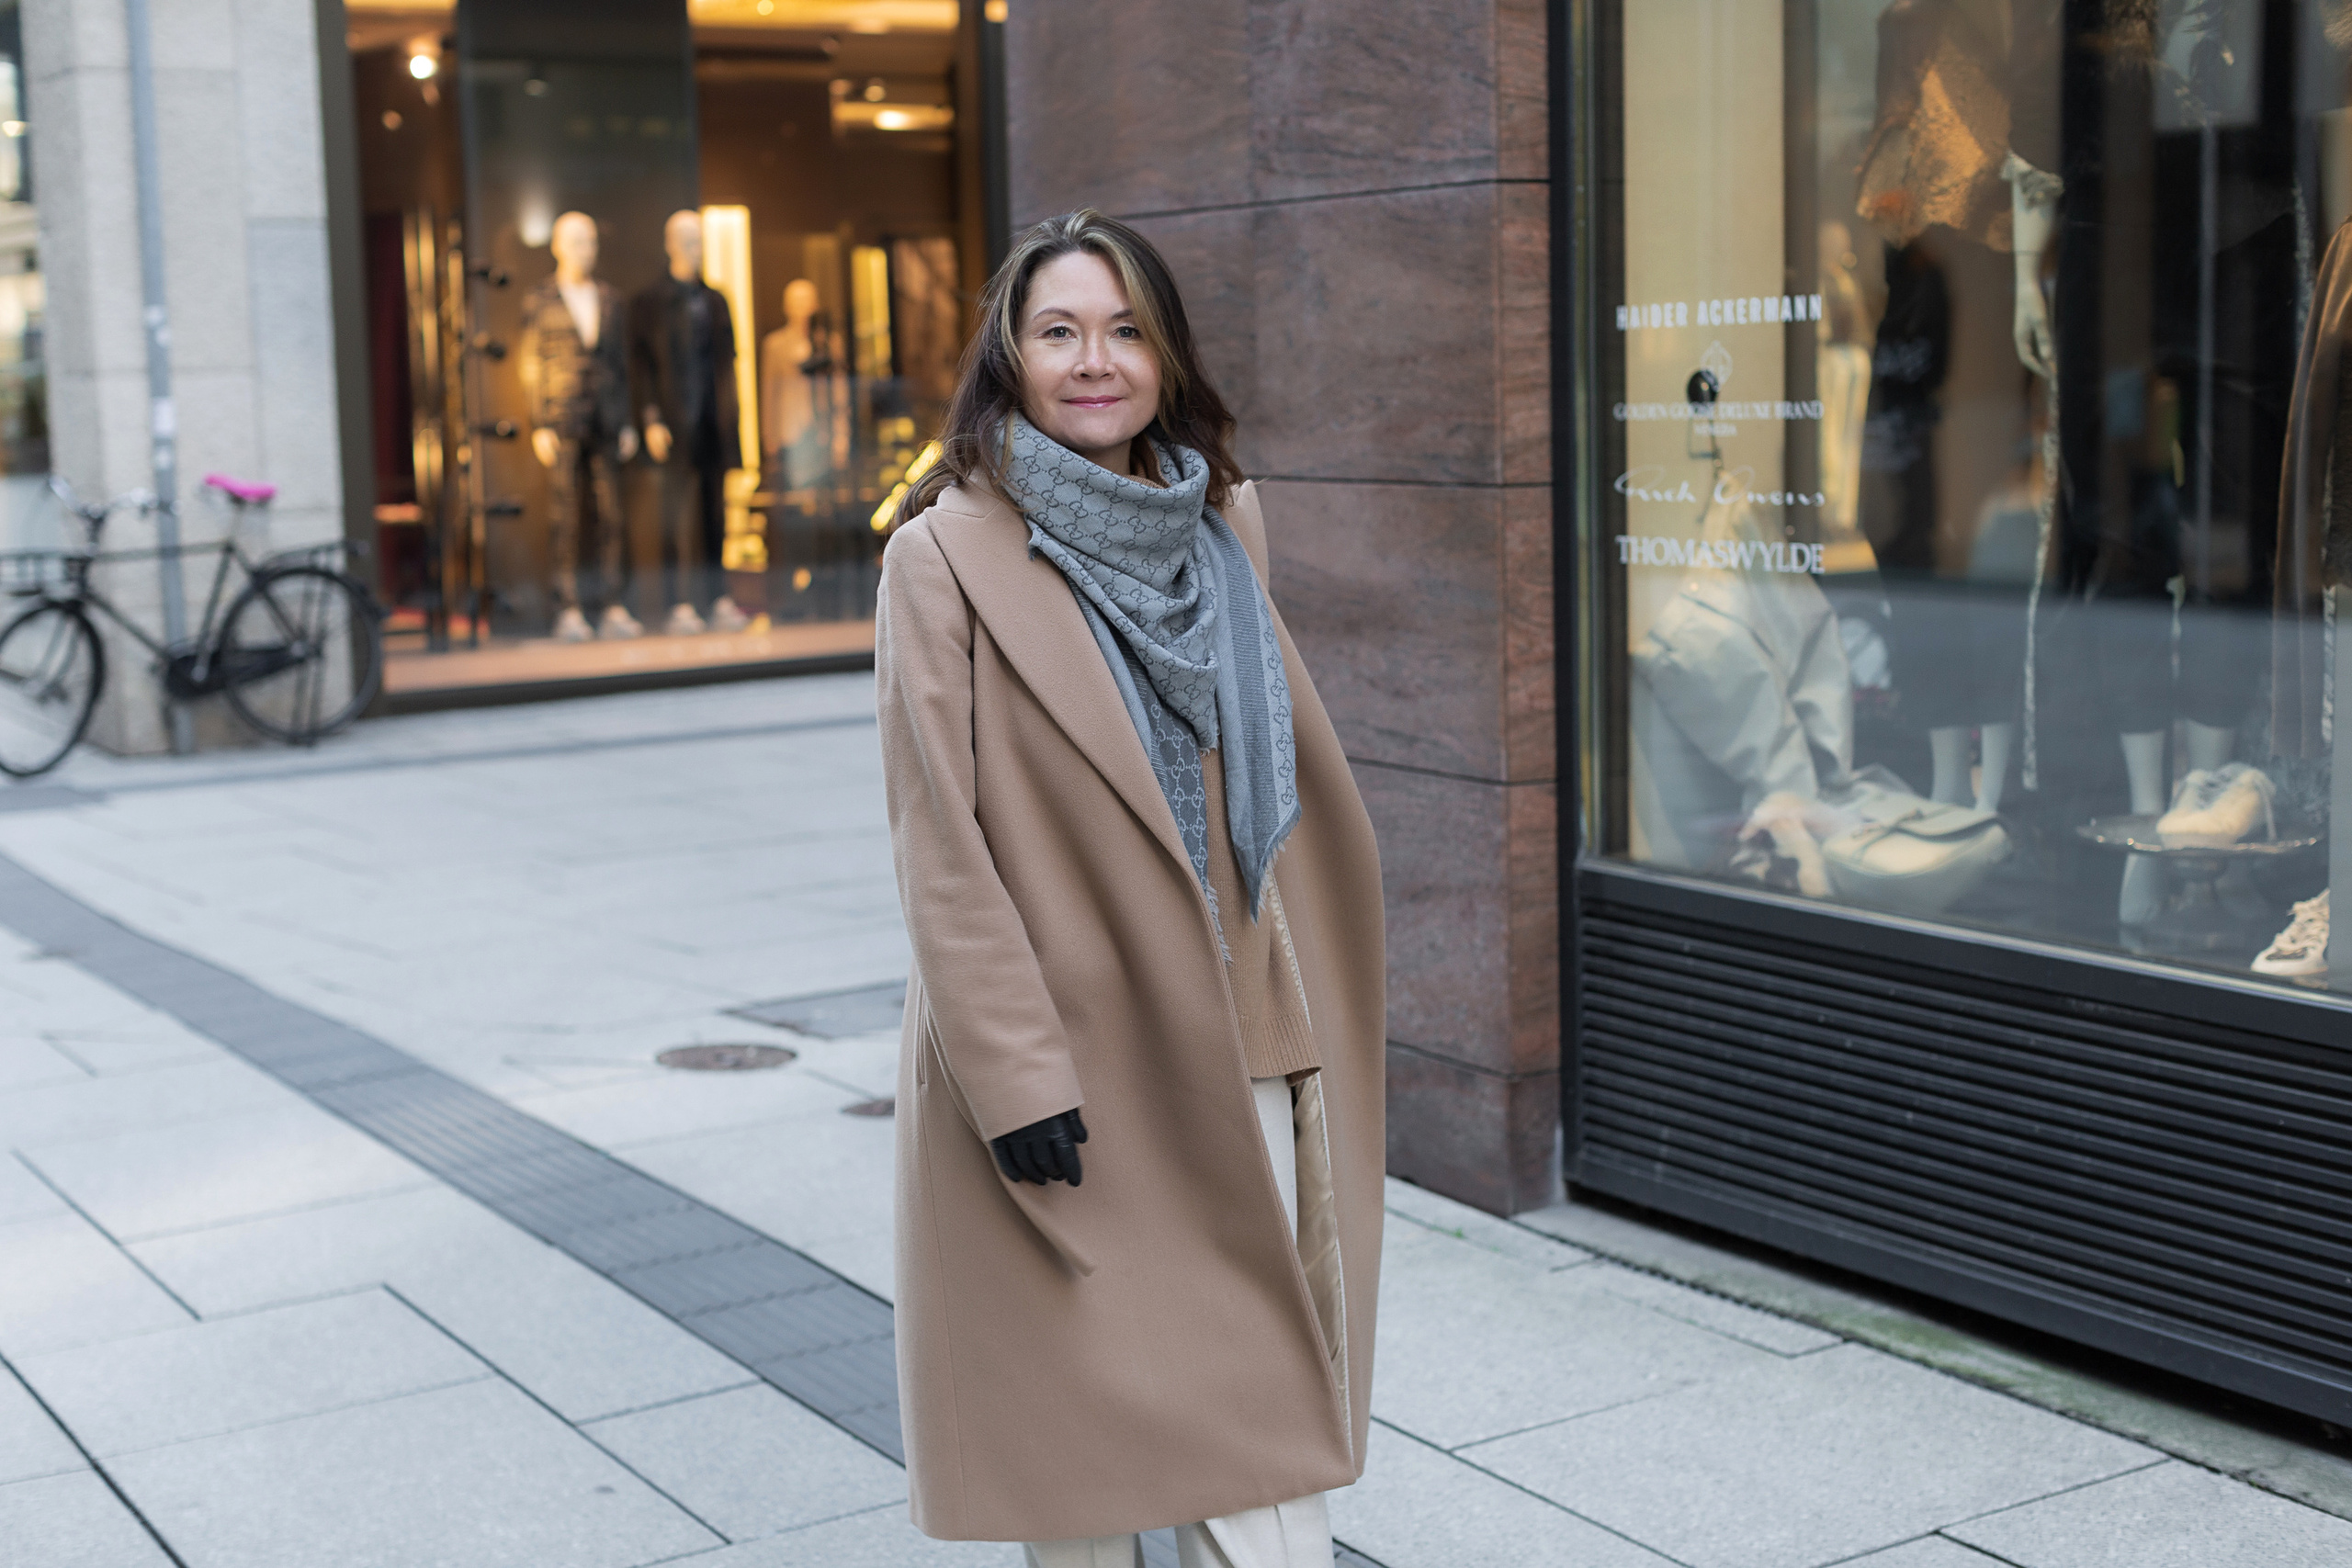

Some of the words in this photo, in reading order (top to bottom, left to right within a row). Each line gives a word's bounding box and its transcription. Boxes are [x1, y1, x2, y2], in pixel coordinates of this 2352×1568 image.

[1616, 302, 1688, 331] HAIDER
[1697, 294, 1822, 326] ACKERMANN
[1775, 400, 1824, 420] BRAND
